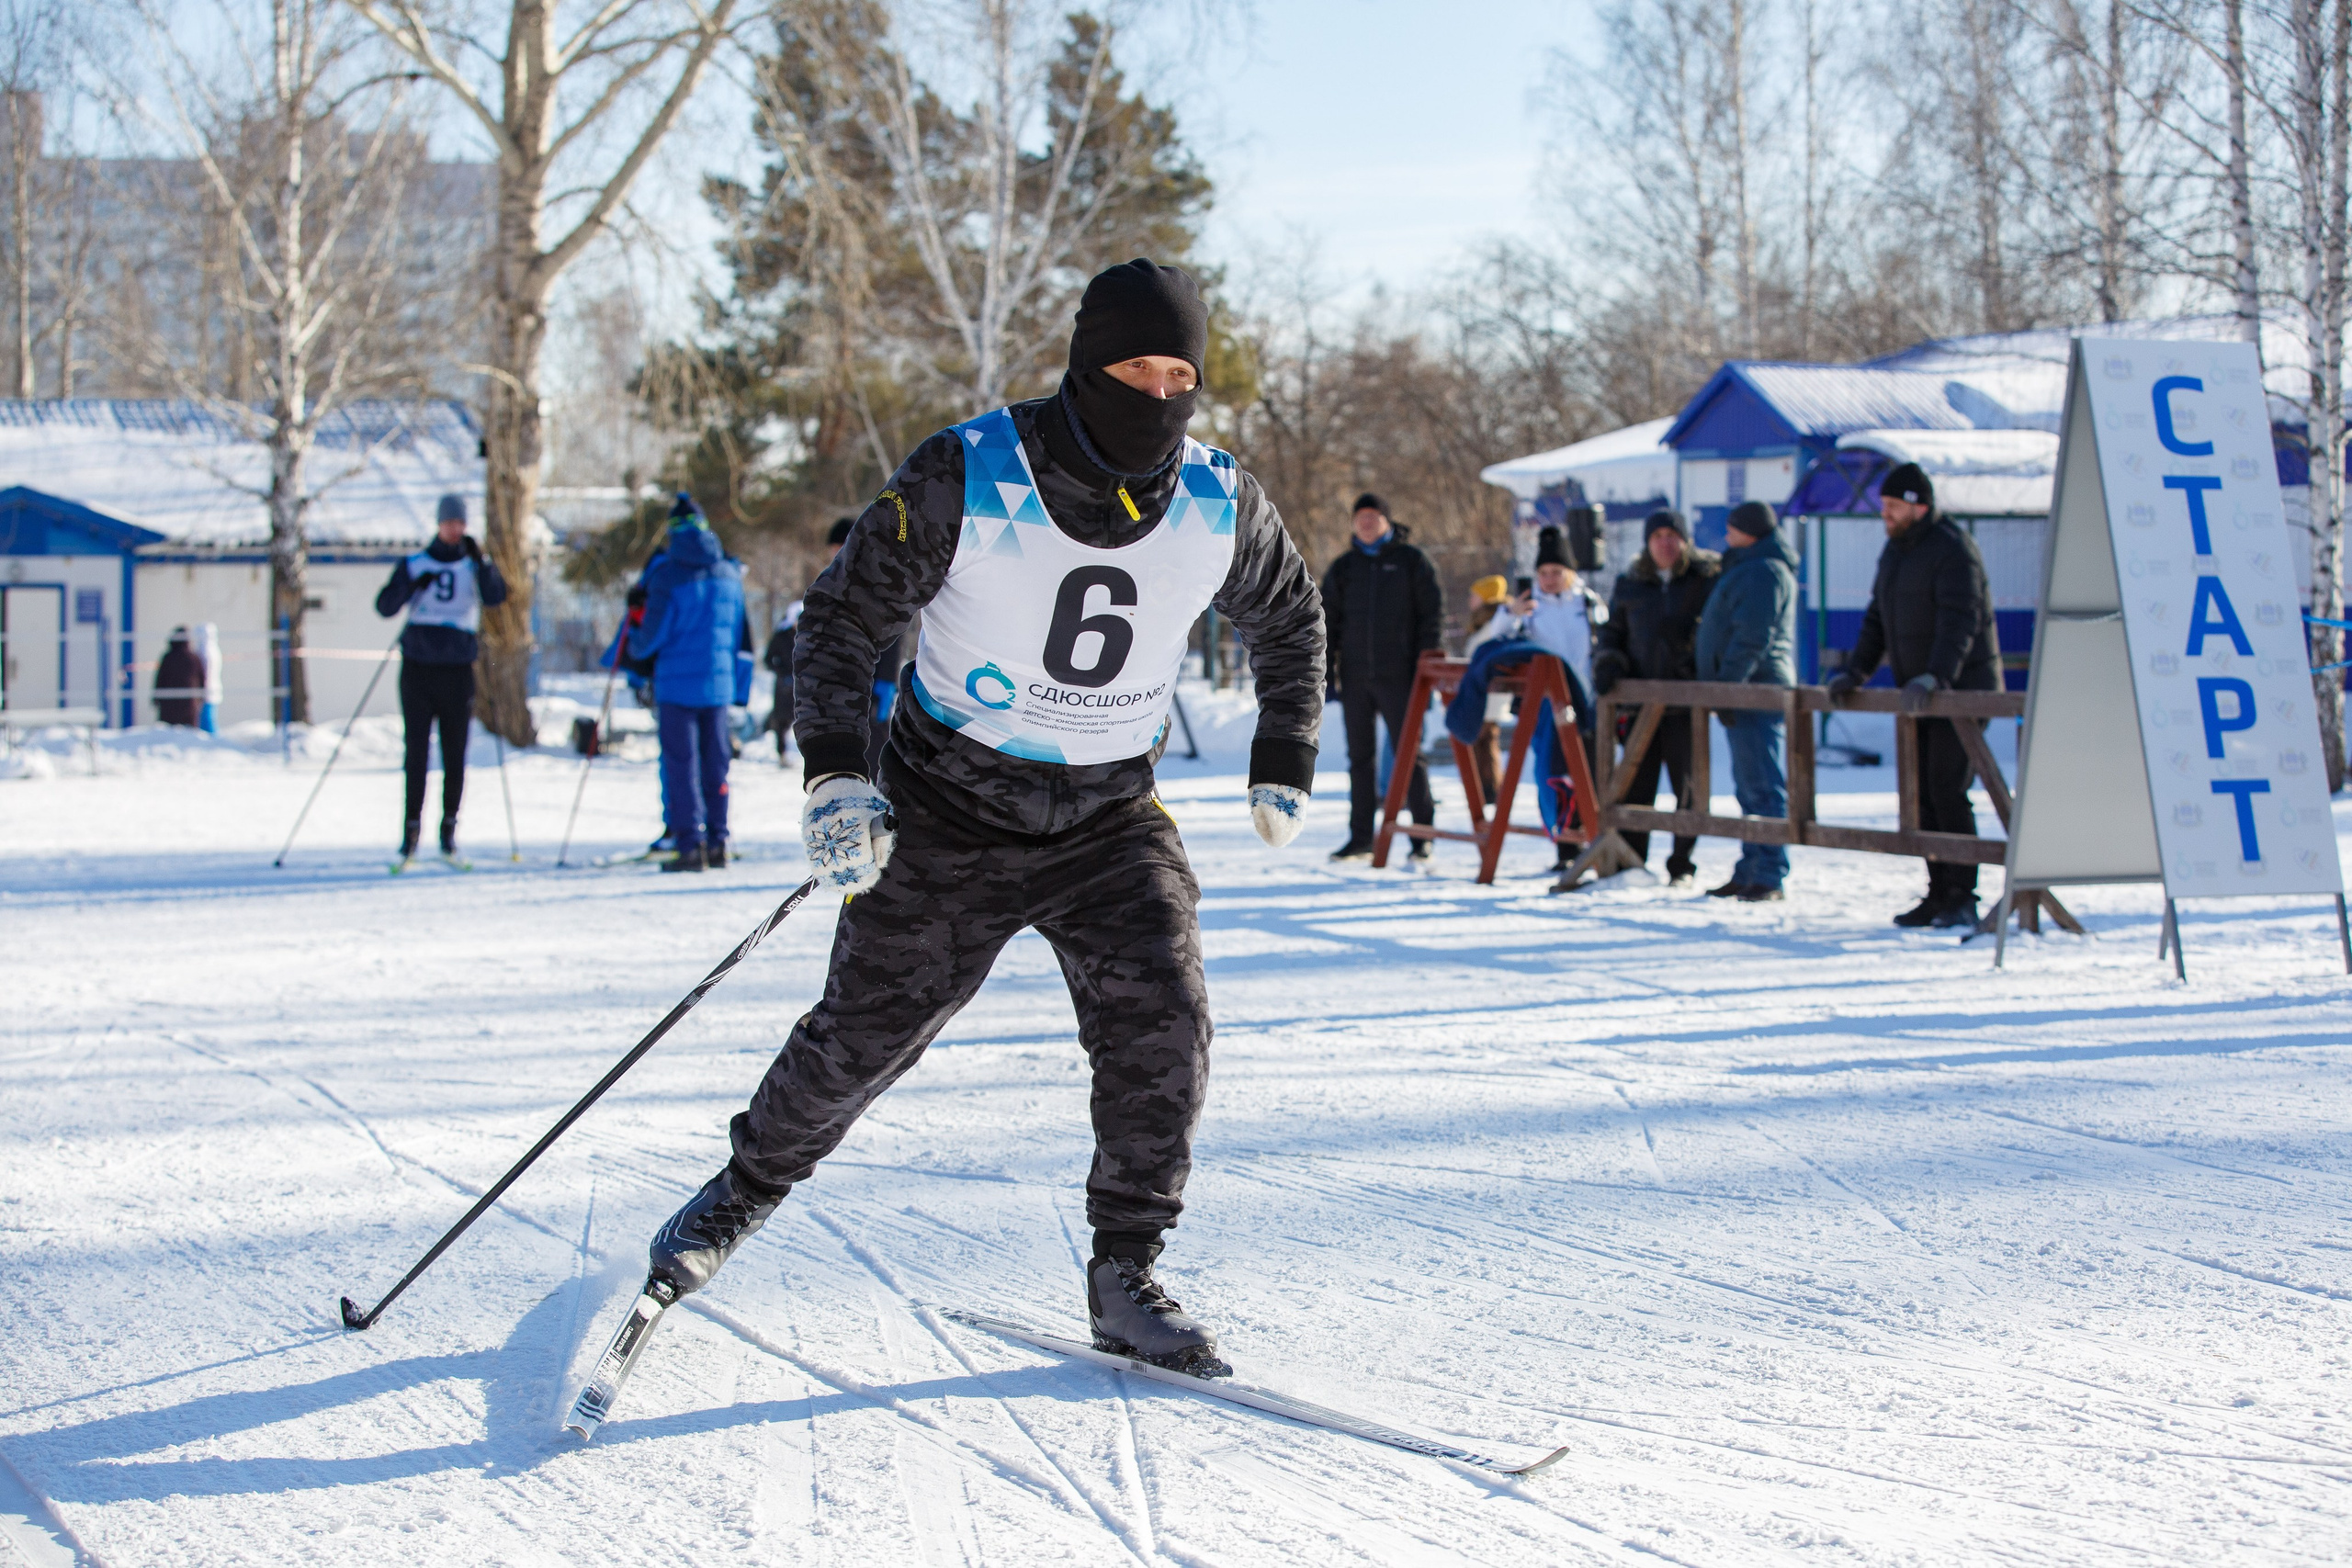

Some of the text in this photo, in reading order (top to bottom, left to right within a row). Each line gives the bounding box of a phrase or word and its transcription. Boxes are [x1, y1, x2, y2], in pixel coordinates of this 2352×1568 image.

[436, 570, 455, 602] 9
[1042, 564, 1138, 688] 6
[2151, 375, 2271, 862] СТАРТ
[1028, 682, 1166, 707] СДЮСШОР №2
[1025, 701, 1109, 719] Специализированная
[1099, 716, 1137, 727] спортивная
[1021, 717, 1079, 733] олимпийского
[784, 895, 805, 911] TREK
[737, 932, 755, 960] SPEED
